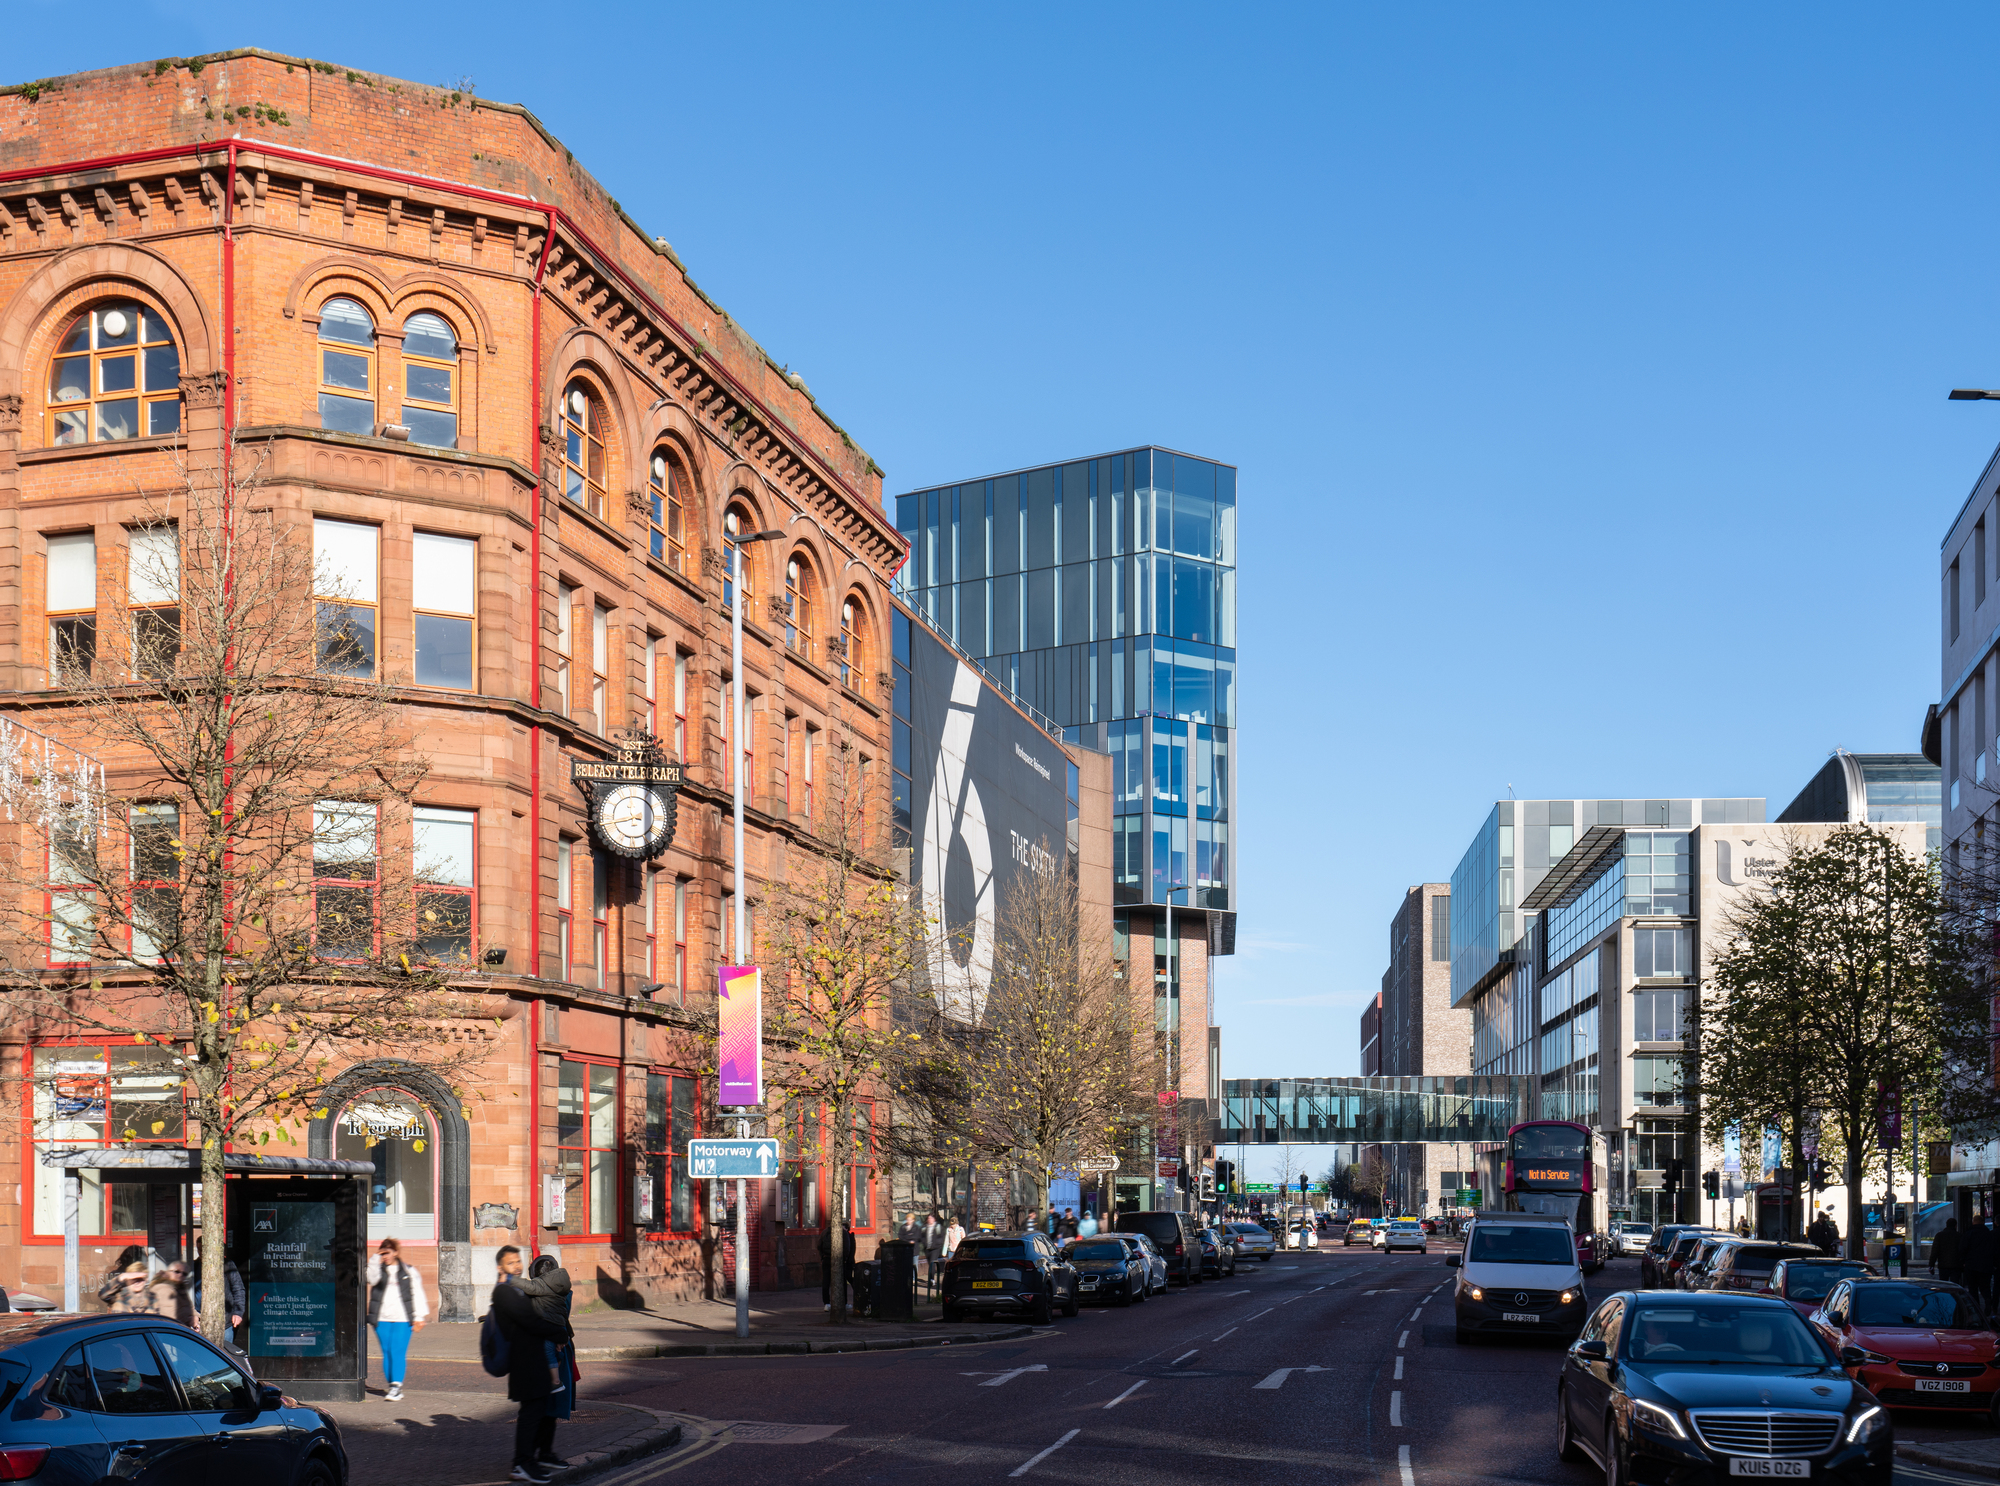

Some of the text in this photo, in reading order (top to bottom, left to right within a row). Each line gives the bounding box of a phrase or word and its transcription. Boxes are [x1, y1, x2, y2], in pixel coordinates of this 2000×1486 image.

[623, 740, 643, 750] EST
[616, 750, 654, 764] 1870
[574, 763, 680, 781] BELFAST TELEGRAPH
[1010, 828, 1029, 868] THE
[1744, 857, 1777, 868] Ulster
[694, 1145, 753, 1158] Motorway
[694, 1158, 716, 1175] M2
[1528, 1169, 1540, 1180] Not
[1546, 1169, 1570, 1180] Service
[254, 1220, 273, 1230] AXA
[267, 1242, 307, 1252] Rainfall
[263, 1252, 301, 1260] in Ireland
[270, 1259, 327, 1270] is increasing
[263, 1295, 311, 1303] Unlike this ad,
[289, 1309, 314, 1317] change
[1506, 1313, 1520, 1321] LRZ
[1921, 1380, 1965, 1391] VGZ 1908
[1738, 1460, 1803, 1476] KU15 OZG
